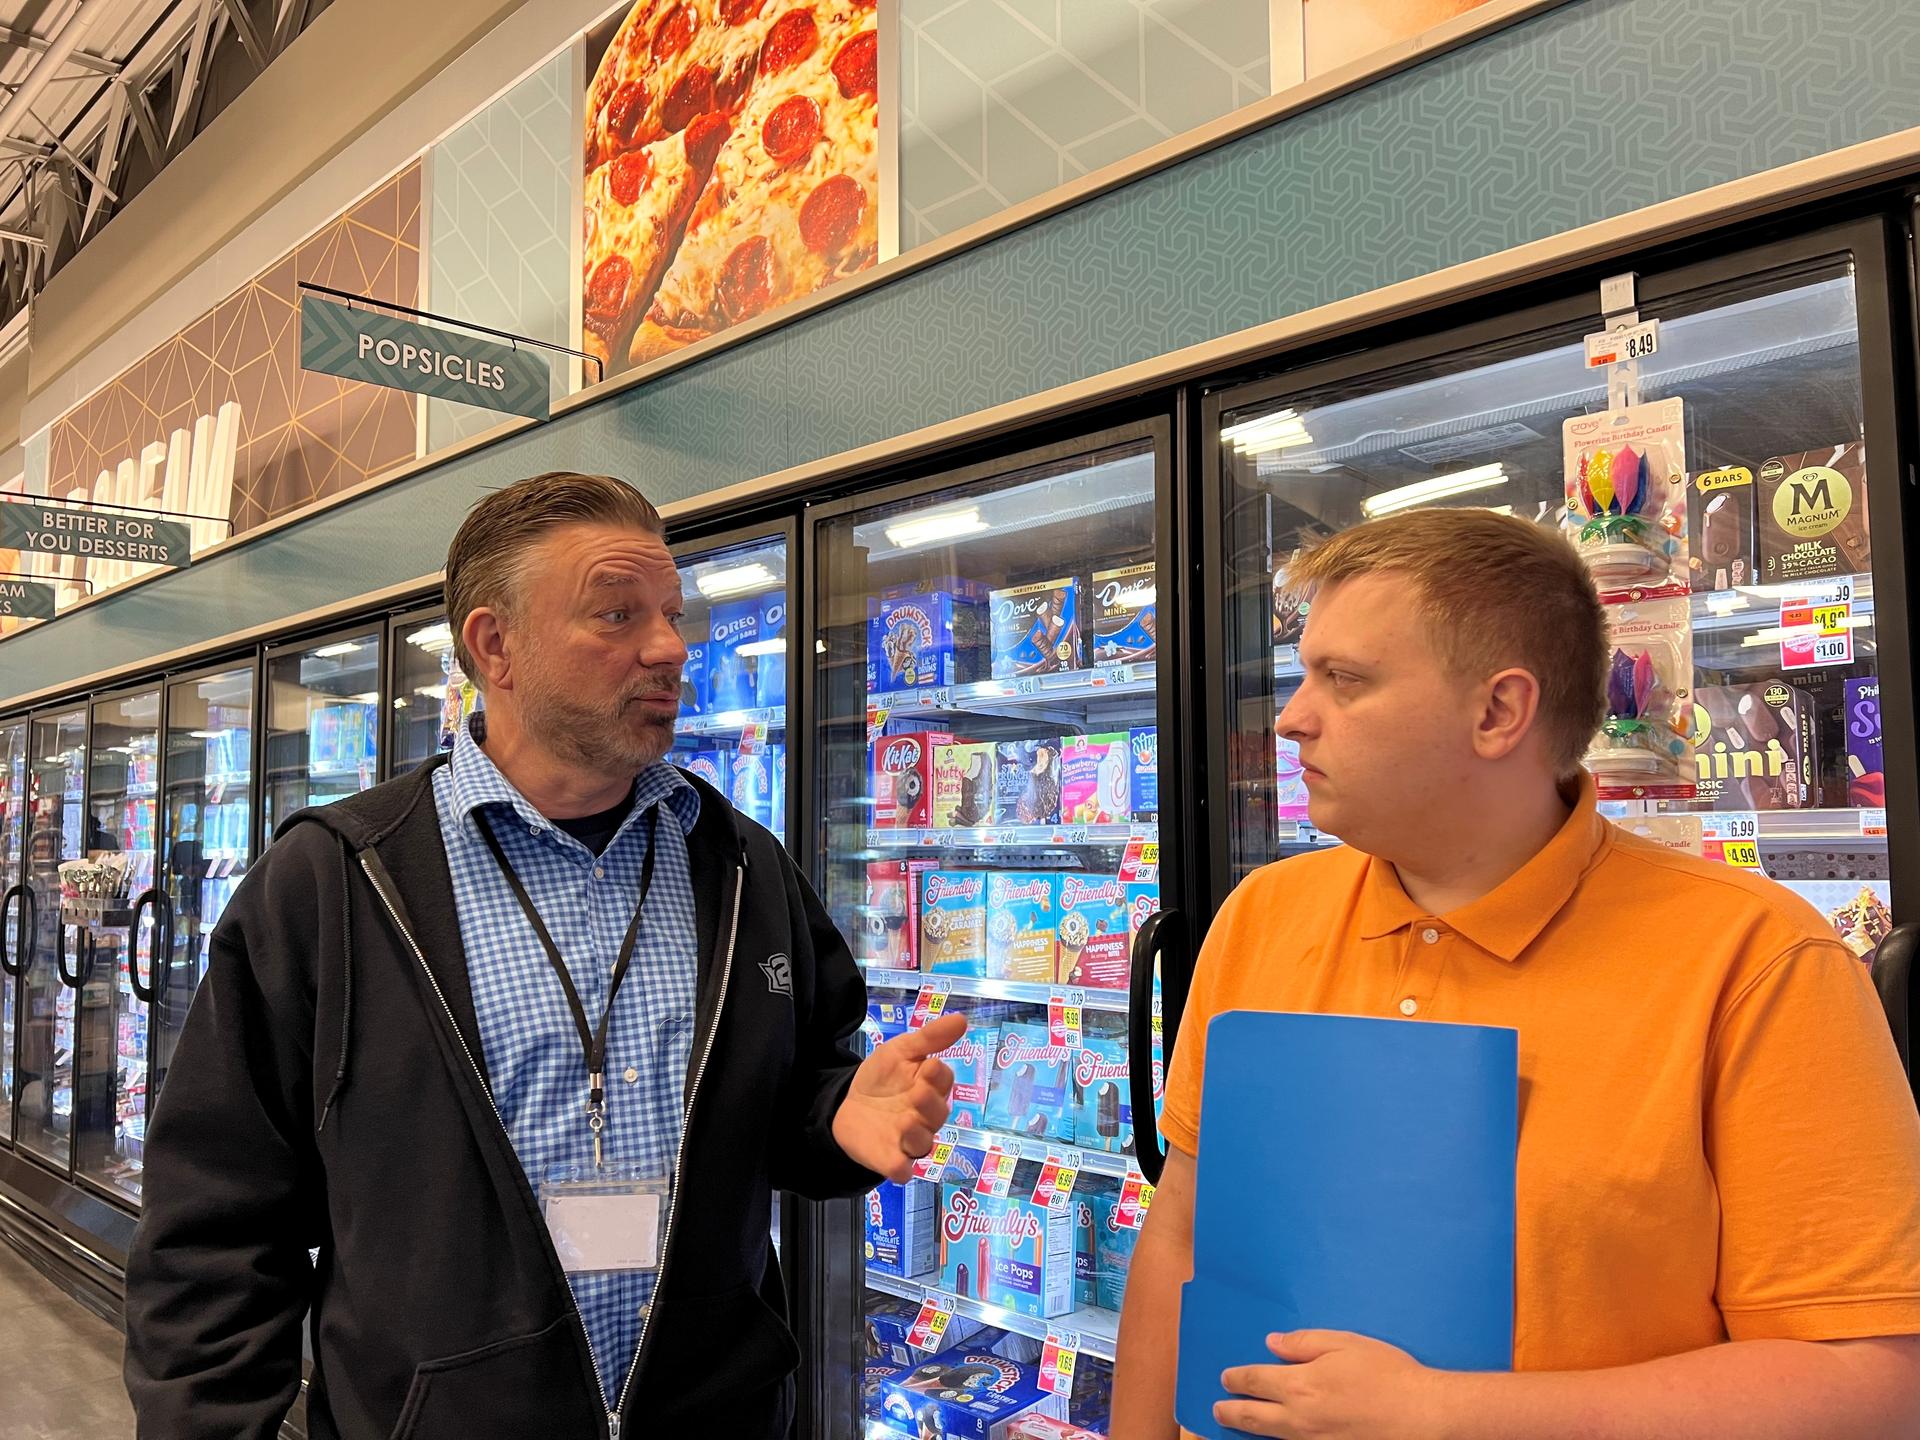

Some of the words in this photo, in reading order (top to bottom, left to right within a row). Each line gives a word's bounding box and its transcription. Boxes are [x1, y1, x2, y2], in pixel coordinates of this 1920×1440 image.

[1625, 333, 1653, 358] $8.49
[358, 333, 506, 391] POPSICLES
[1612, 430, 1644, 443] Birthday
[1646, 424, 1672, 435] Candle
[1703, 475, 1711, 486] 6
[1714, 473, 1743, 484] BARS
[1790, 478, 1834, 516] M
[1786, 510, 1839, 526] MAGNUM
[43, 511, 109, 533] BETTER
[115, 520, 155, 540] FOR
[25, 531, 72, 552] YOU
[79, 537, 168, 562] DESSERTS
[1794, 540, 1822, 553] MILK
[1781, 547, 1837, 562] CHOCOLATE
[1799, 556, 1837, 566] CACAO
[1120, 567, 1142, 575] VARIETY
[1804, 567, 1837, 575] CHOCOLATE
[931, 593, 939, 601] 12
[1103, 607, 1127, 617] MINIS
[873, 617, 879, 625] 12
[885, 605, 933, 648] DRUMSTICK
[714, 616, 756, 642] OREO
[1619, 624, 1651, 636] Birthday
[1816, 642, 1845, 657] $1.00
[1793, 671, 1828, 686] mini
[1063, 760, 1098, 773] Strawberry
[936, 767, 965, 782] Nutty
[937, 782, 961, 794] Bars
[1695, 780, 1723, 789] ASSIC
[919, 808, 926, 818] 4
[985, 815, 993, 824] 4
[1050, 814, 1058, 823] 4
[1727, 821, 1754, 837] $6.99
[1142, 848, 1159, 860] $6.99
[1727, 848, 1756, 863] $4.99
[900, 862, 906, 871] 8
[1137, 869, 1150, 878] 50¢
[925, 875, 983, 906] Friendly's
[990, 876, 1051, 909] Friendly's
[1060, 877, 1125, 910] Friendly's
[1013, 937, 1048, 949] HAPPINESS
[1085, 941, 1124, 953] HAPPINESS
[1071, 992, 1084, 1006] $7.79
[896, 1007, 904, 1019] 8
[1064, 1010, 1079, 1026] $6.99
[1066, 1033, 1078, 1044] 80¢
[996, 1032, 1070, 1068] Friendly's
[1067, 1152, 1079, 1168] $7.79
[1057, 1172, 1072, 1187] $6.99
[1050, 1194, 1063, 1204] 80¢
[1140, 1188, 1153, 1203] $6.9
[944, 1191, 1039, 1248] Friendly's
[994, 1259, 1009, 1272] Ice
[1010, 1262, 1035, 1280] Pops
[1084, 1290, 1093, 1298] 20
[1028, 1304, 1038, 1313] 20
[1059, 1354, 1073, 1371] $7.69
[964, 1355, 1021, 1393] DRUMSTICK
[976, 1418, 983, 1429] 8
